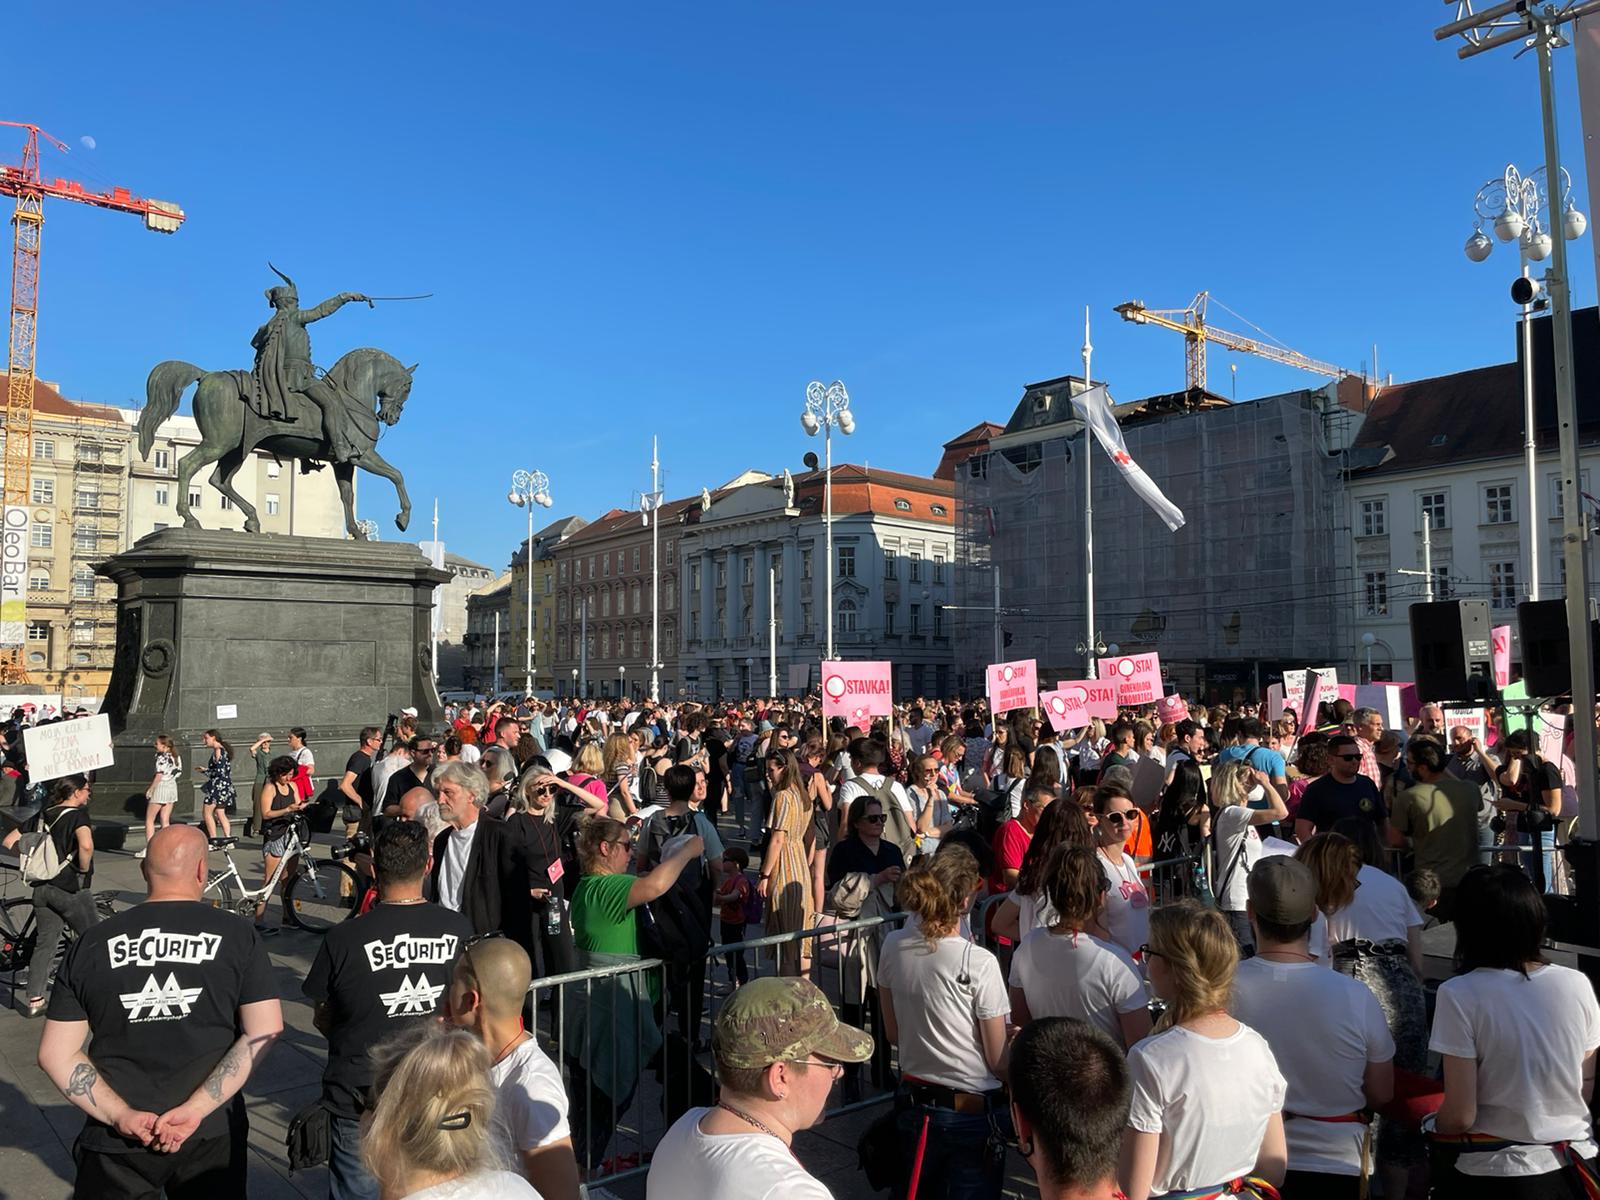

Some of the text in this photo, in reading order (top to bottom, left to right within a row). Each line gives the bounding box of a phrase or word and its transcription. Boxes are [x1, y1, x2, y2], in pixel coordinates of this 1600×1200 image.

[1109, 658, 1152, 679] DOSTA!
[825, 675, 889, 702] OSTAVKA!
[113, 936, 218, 963] SECURITY
[372, 938, 456, 967] SECURITY
